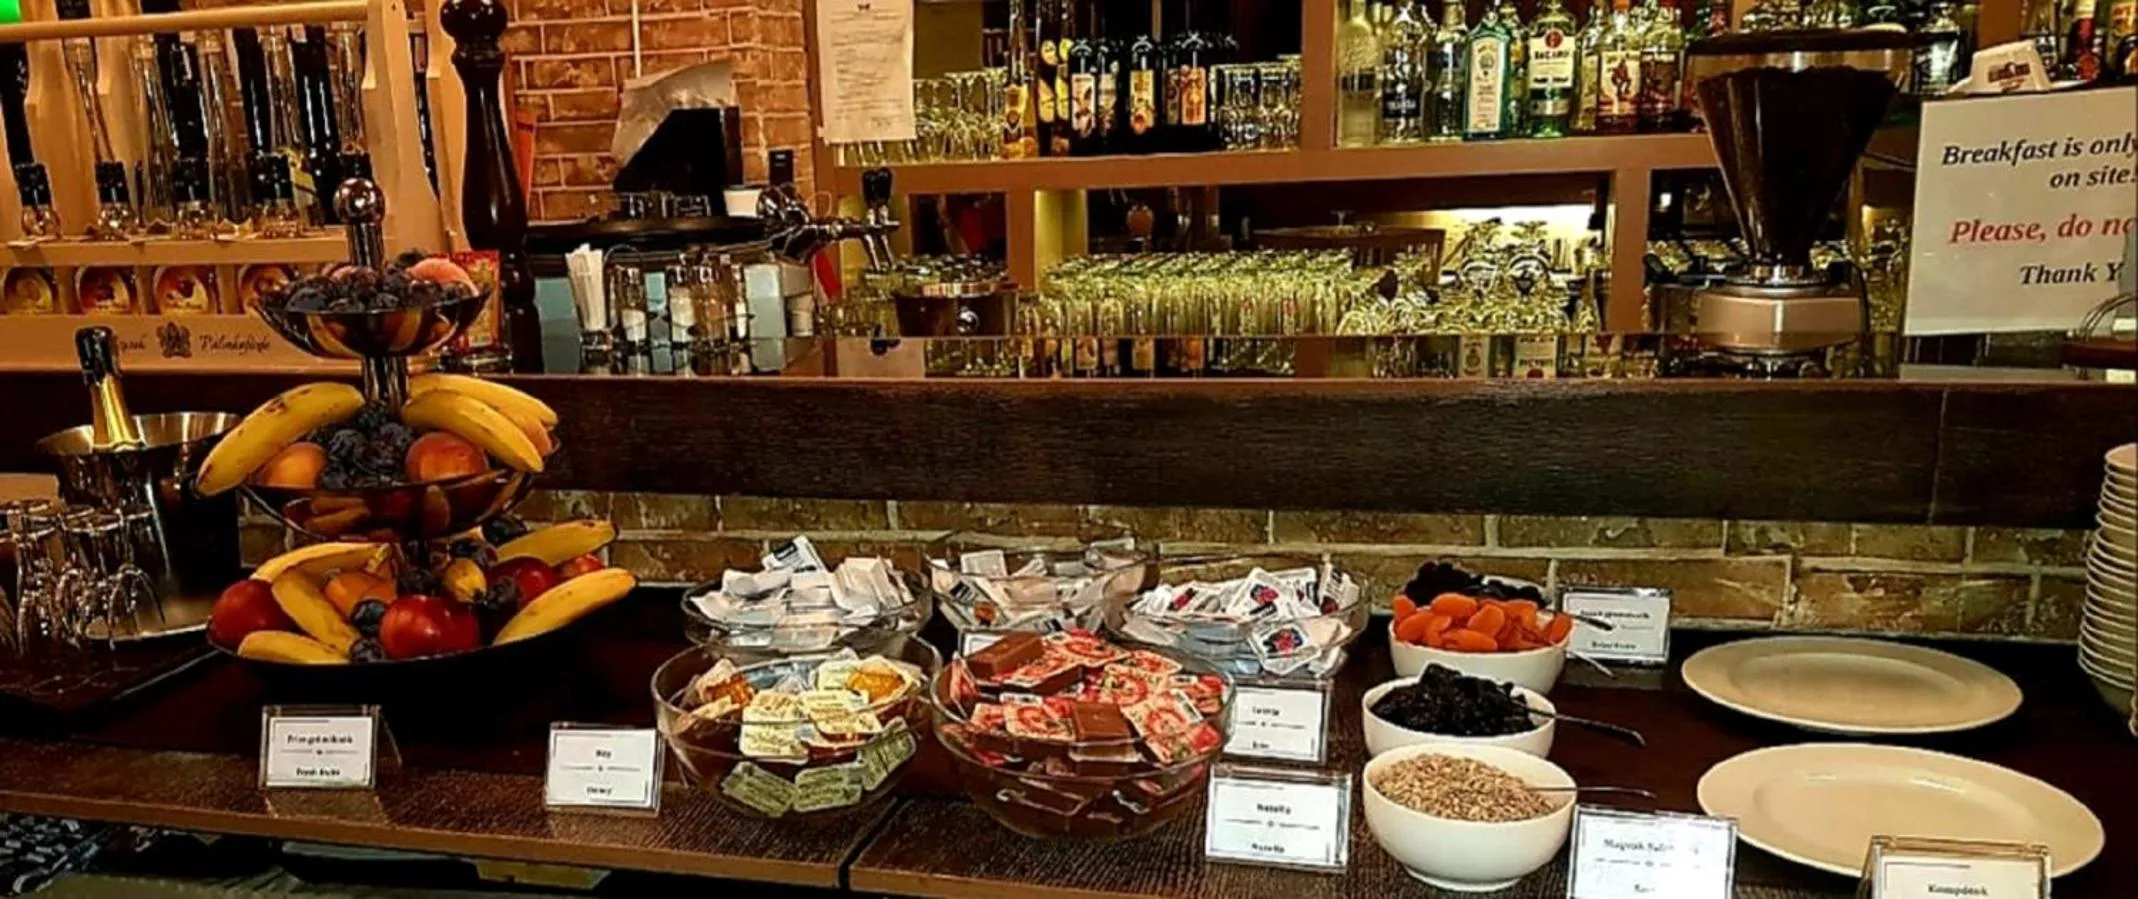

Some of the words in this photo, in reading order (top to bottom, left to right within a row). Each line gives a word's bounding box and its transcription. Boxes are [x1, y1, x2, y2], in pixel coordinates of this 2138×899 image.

[1942, 139, 2058, 167] Breakfast
[2062, 137, 2084, 157] is
[2050, 172, 2080, 188] on
[1950, 219, 2046, 244] Please,
[2057, 213, 2093, 237] do
[2020, 262, 2098, 285] Thank
[2106, 262, 2125, 281] Y
